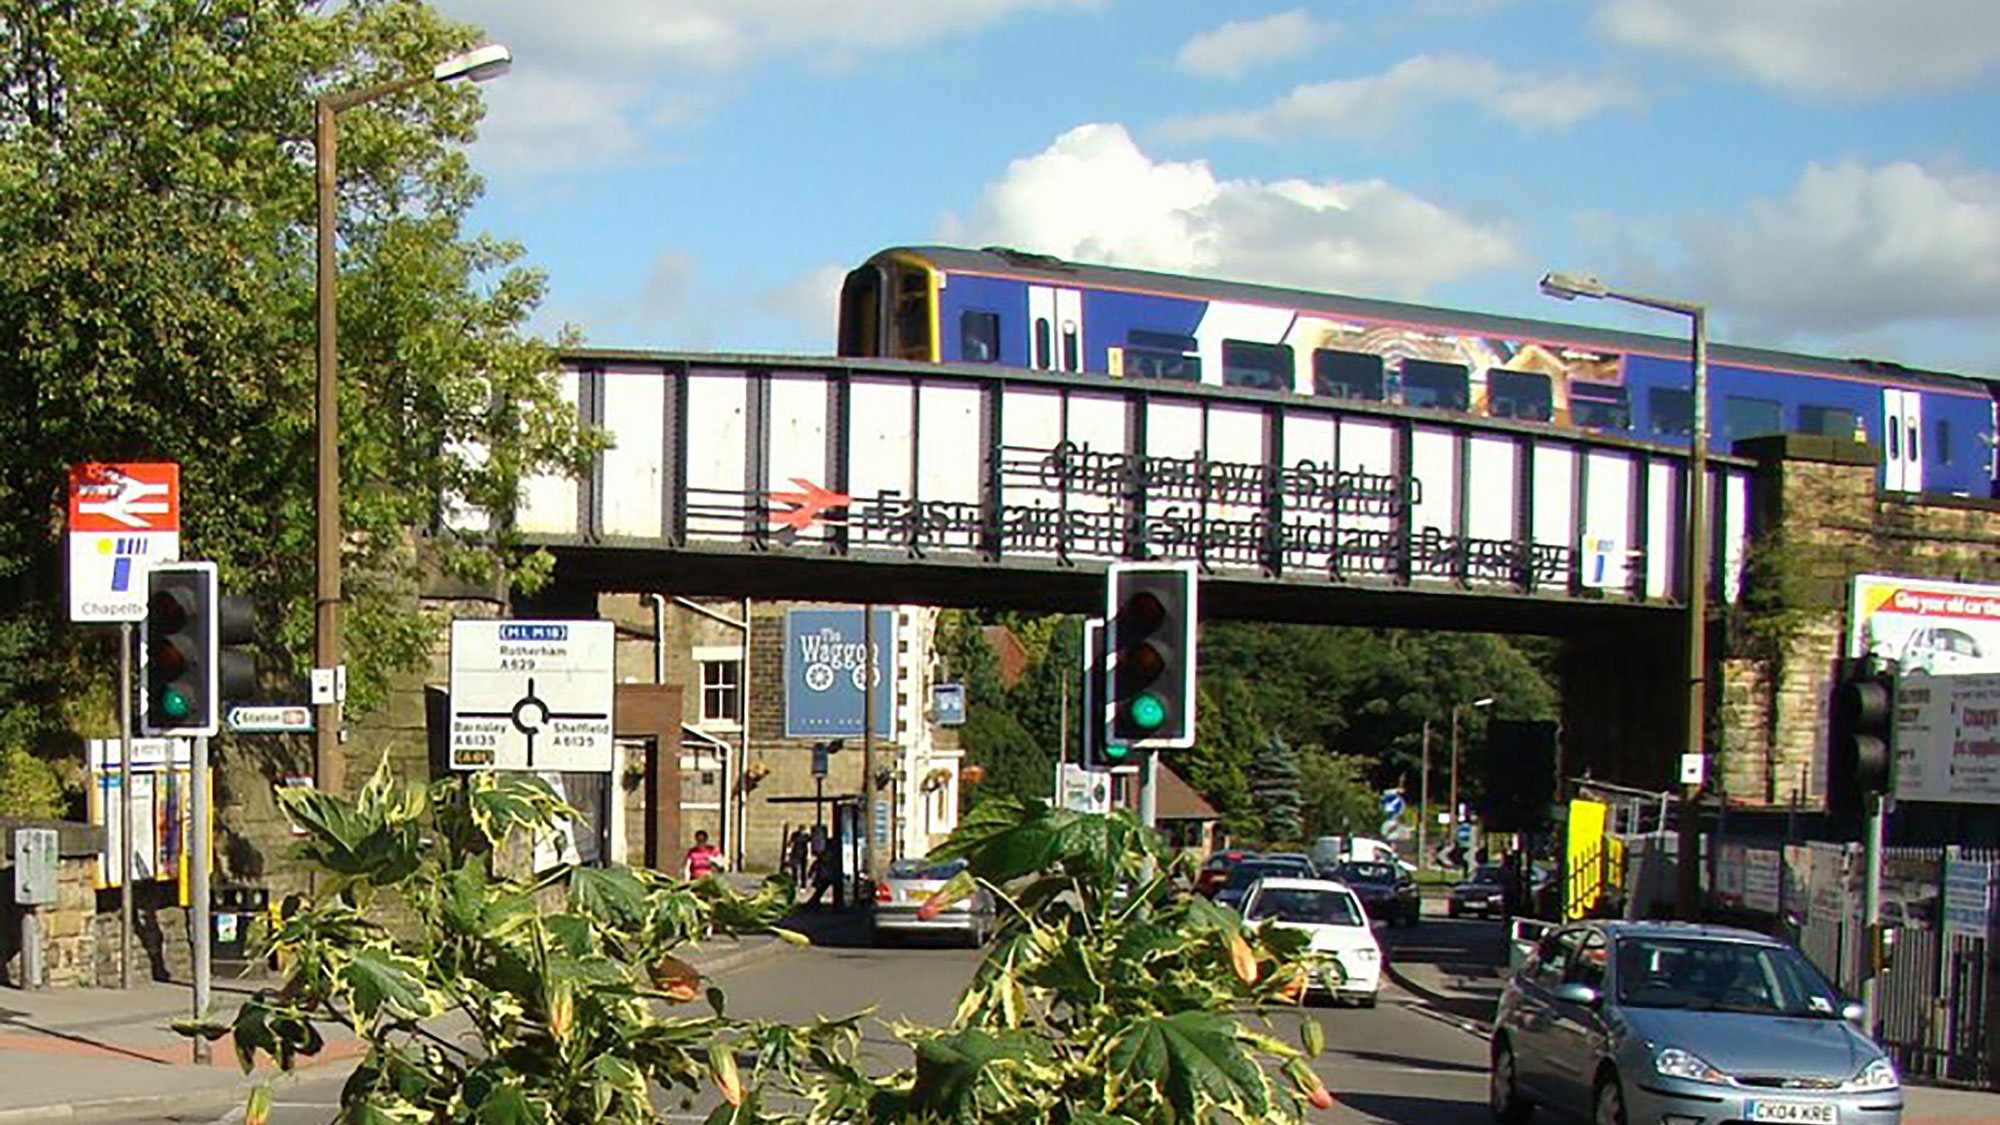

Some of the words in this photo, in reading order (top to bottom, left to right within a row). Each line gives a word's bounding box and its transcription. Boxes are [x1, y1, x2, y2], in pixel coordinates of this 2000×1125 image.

[1162, 506, 1325, 552] Shefeld
[820, 627, 841, 642] The
[500, 645, 567, 656] Rotherham
[453, 721, 508, 734] Barnsley
[553, 722, 610, 735] Sheffield
